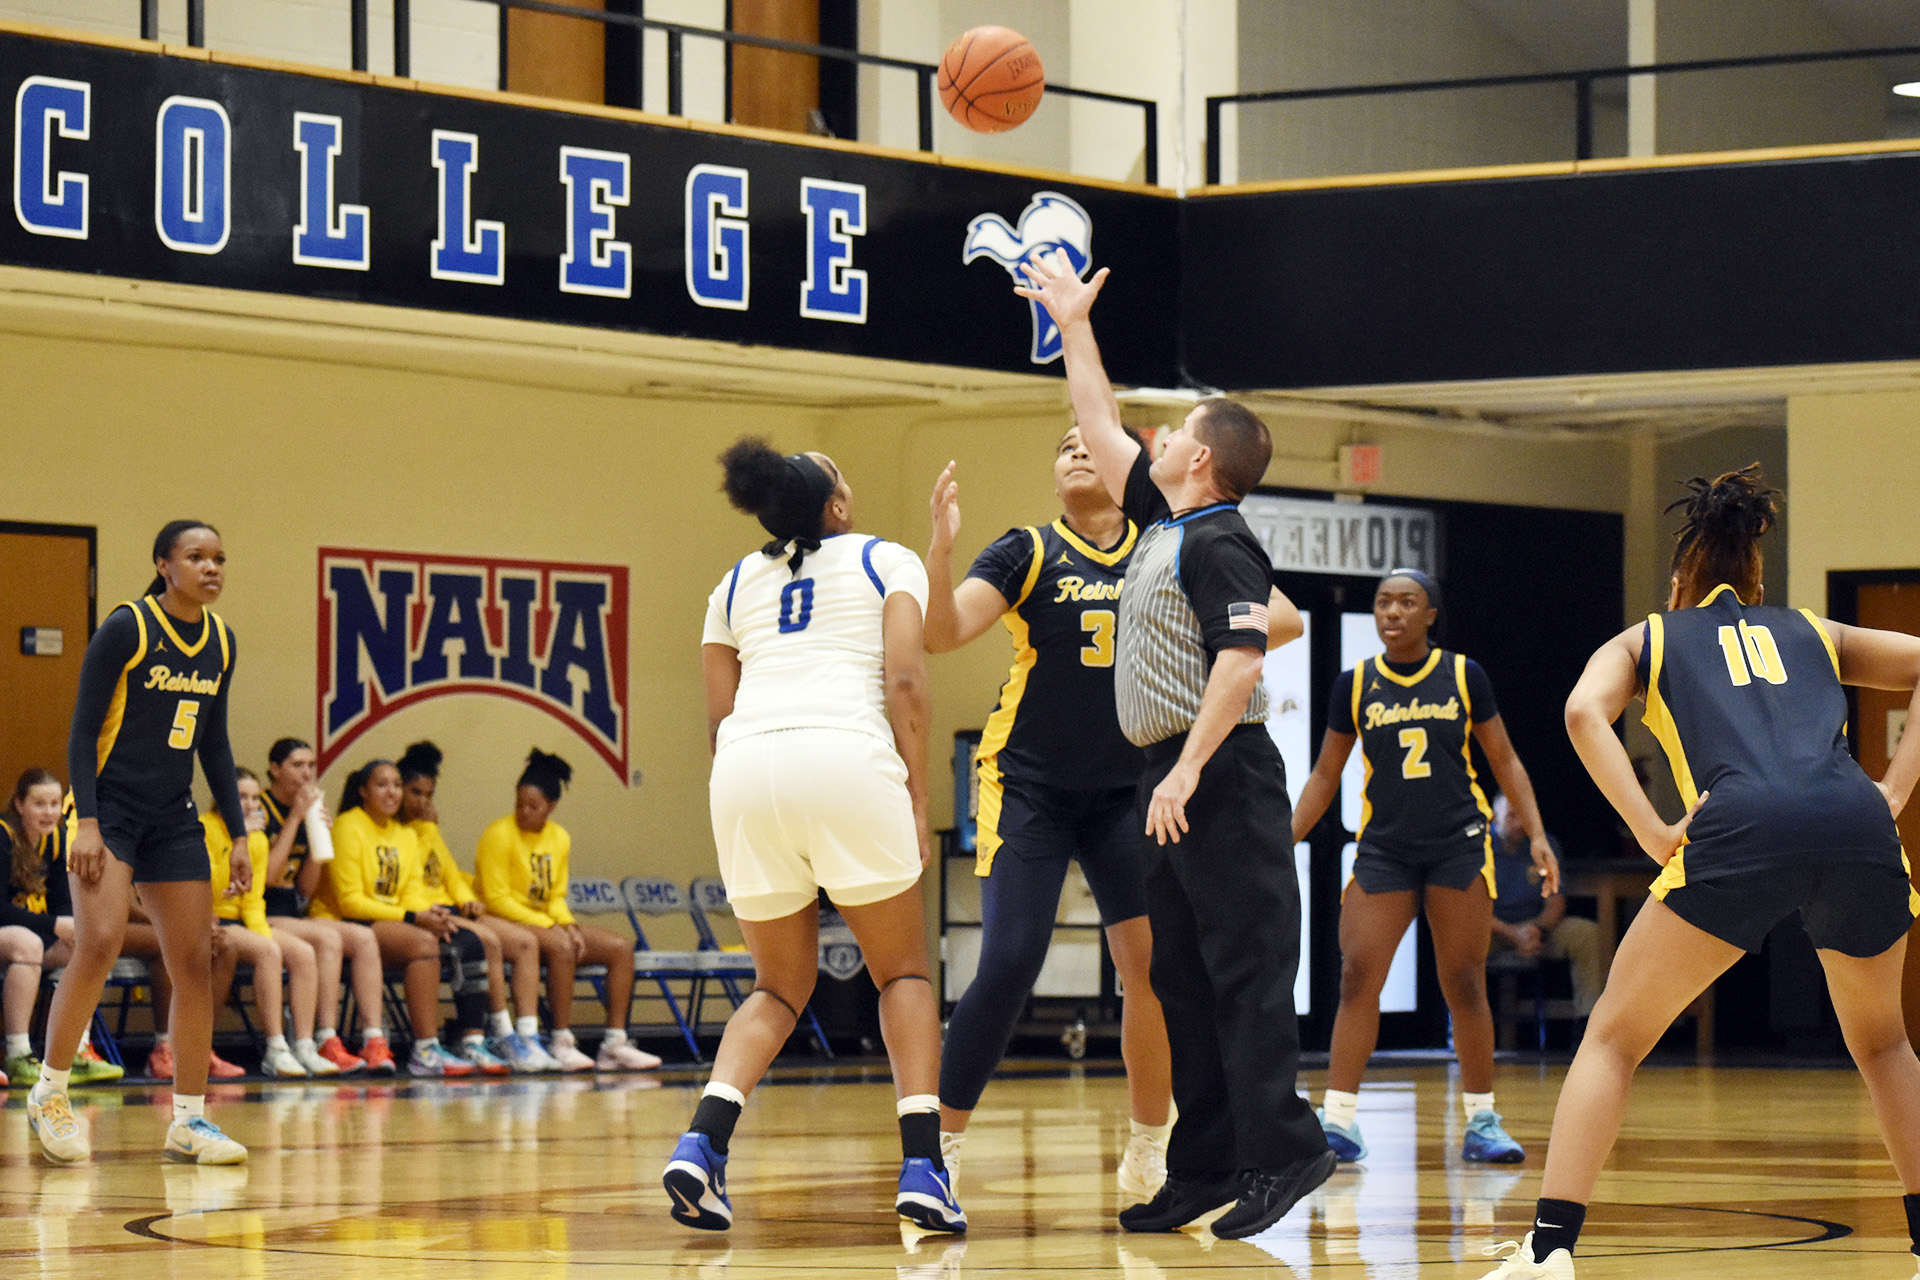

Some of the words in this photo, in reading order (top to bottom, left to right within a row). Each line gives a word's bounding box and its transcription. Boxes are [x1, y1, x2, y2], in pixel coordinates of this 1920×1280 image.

[14, 75, 868, 324] COLLEGE
[778, 577, 815, 634] 0
[323, 556, 623, 762] NAIA
[1080, 609, 1116, 668] 3
[1718, 618, 1788, 687] 10
[144, 664, 222, 696] Reinhard
[168, 699, 200, 750] 5
[1365, 696, 1460, 731] Reinhardt
[1398, 726, 1432, 780] 2
[570, 883, 615, 904] SMC
[635, 883, 678, 904] SMC
[704, 883, 728, 905] SM
